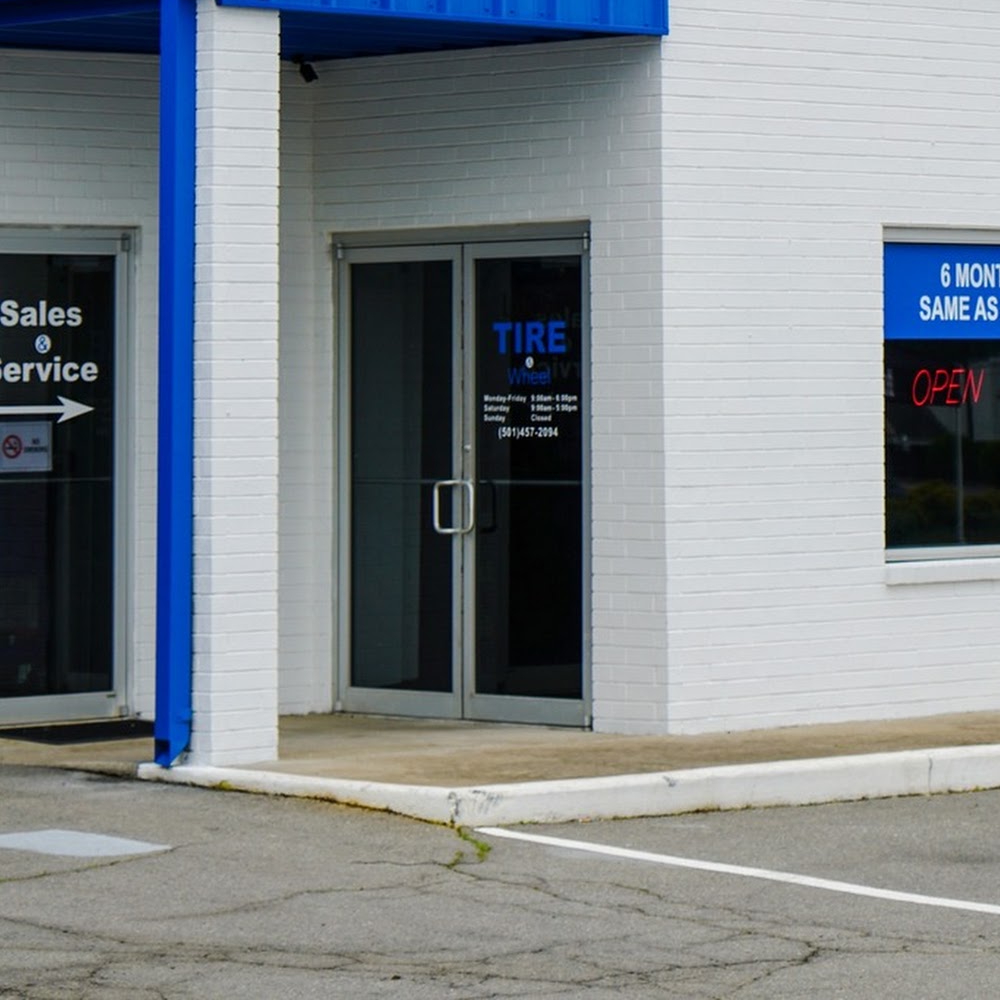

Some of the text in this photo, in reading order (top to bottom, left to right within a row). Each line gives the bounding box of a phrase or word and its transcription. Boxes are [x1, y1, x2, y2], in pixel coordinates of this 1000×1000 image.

[940, 262, 951, 288] 6
[0, 299, 83, 327] Sales
[919, 295, 971, 321] SAME
[973, 296, 999, 321] AS
[492, 320, 567, 354] TIRE
[0, 355, 99, 383] ervice
[912, 368, 985, 407] OPEN
[484, 404, 510, 413] Saturday
[484, 413, 553, 423] Sunday Closed
